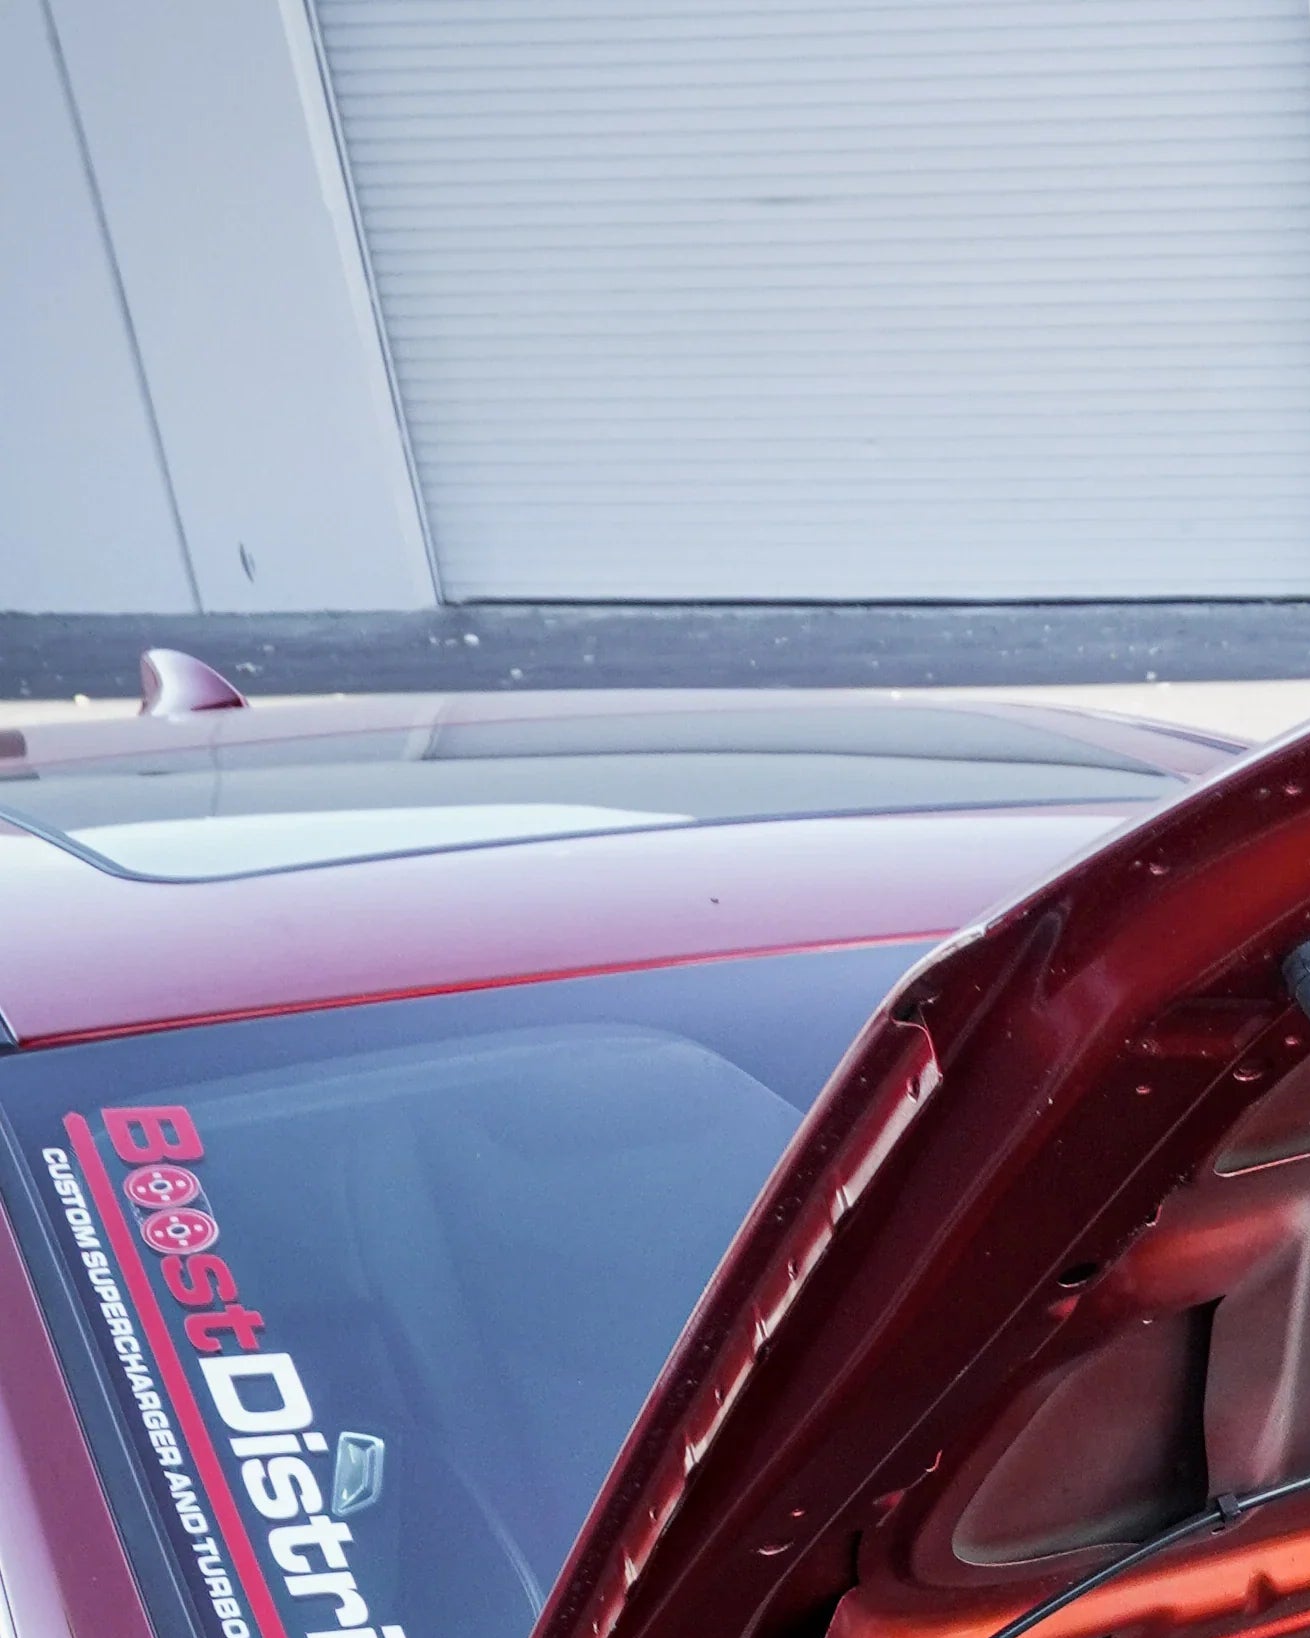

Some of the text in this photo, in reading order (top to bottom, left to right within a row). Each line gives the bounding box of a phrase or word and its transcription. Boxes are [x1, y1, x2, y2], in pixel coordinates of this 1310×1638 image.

[42, 1146, 99, 1249] CUSTOM
[80, 1250, 182, 1466] SUPERCHARGER
[161, 1467, 202, 1536] AND
